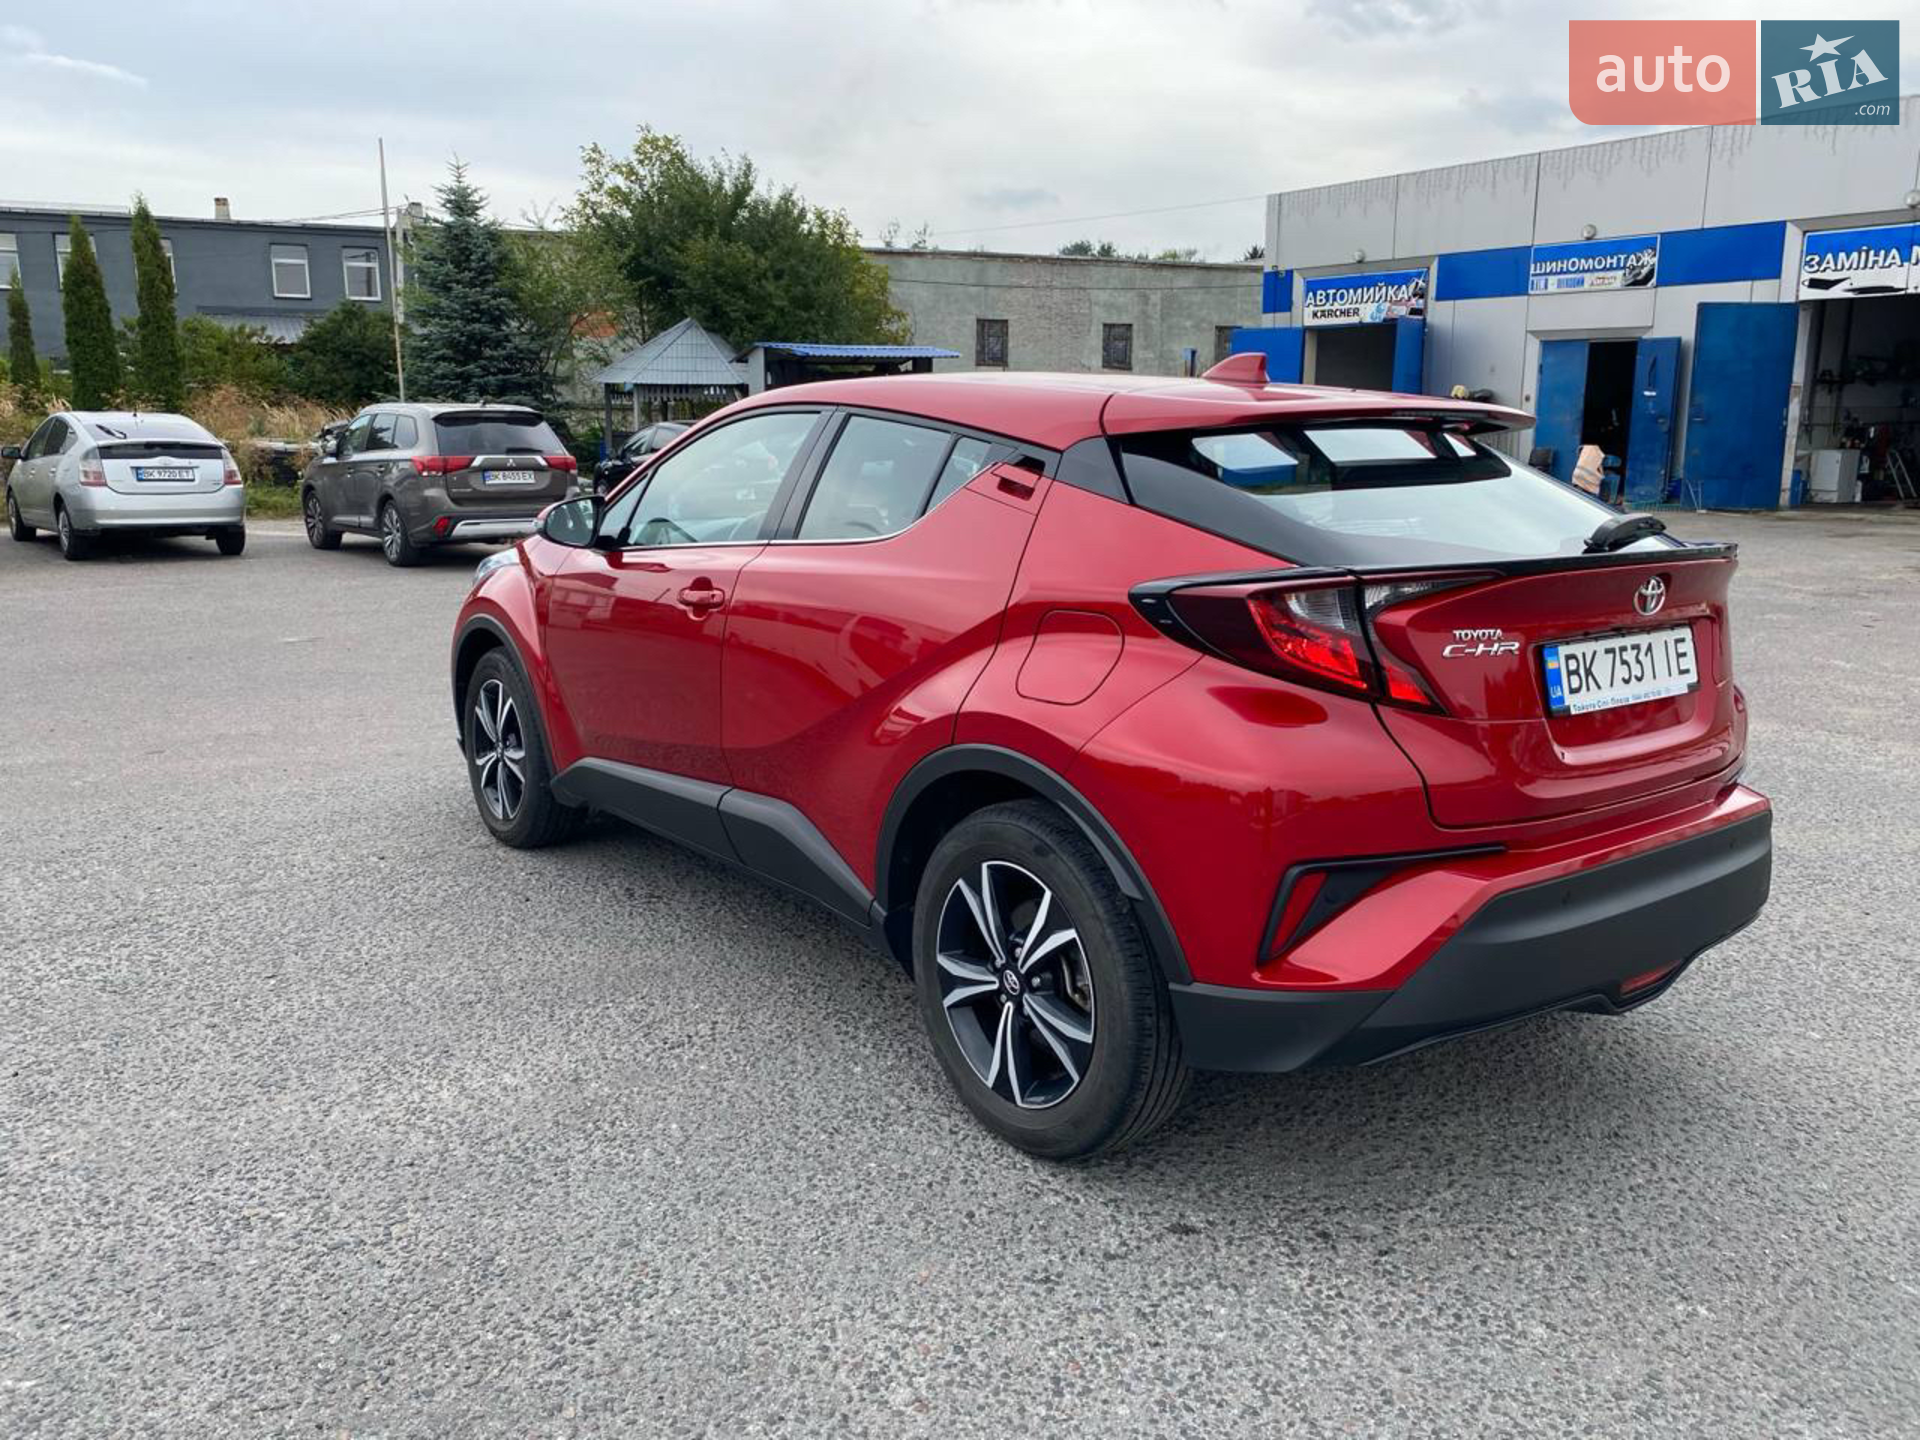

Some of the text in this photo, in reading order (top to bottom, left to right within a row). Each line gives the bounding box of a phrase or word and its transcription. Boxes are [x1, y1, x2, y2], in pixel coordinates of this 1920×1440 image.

[1529, 252, 1656, 275] ШИНОМОНТАЖ
[1305, 281, 1409, 308] АВТОМИЙКА
[157, 468, 178, 479] 9720
[1452, 628, 1504, 641] TOYOTA
[1442, 641, 1520, 658] C-HR
[1564, 637, 1690, 695] BK 7531 IE
